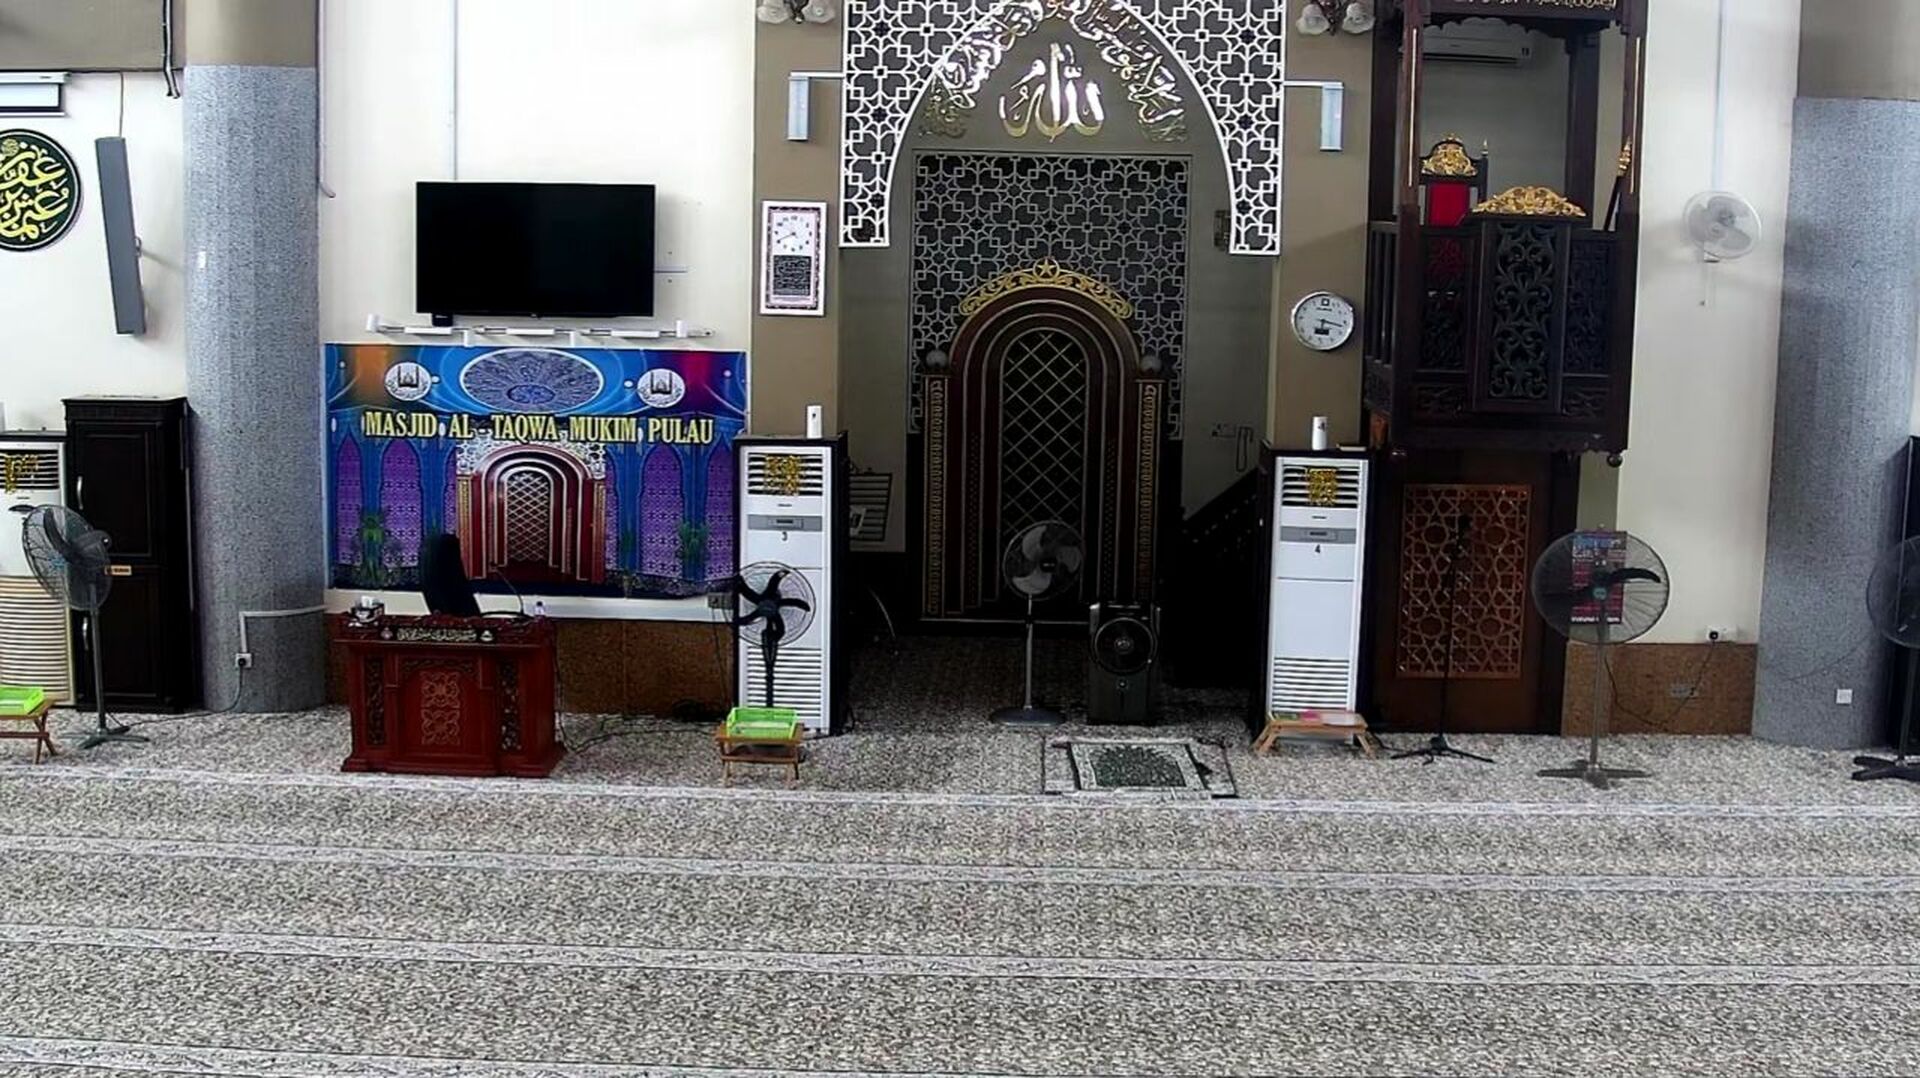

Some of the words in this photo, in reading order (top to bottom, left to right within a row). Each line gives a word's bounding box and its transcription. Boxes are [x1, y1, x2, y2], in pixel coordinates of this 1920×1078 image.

[365, 411, 438, 437] MASJID
[449, 413, 474, 439] AL
[491, 414, 558, 444] TAQWA
[569, 416, 637, 442] MUKIM
[648, 417, 713, 444] PULAU
